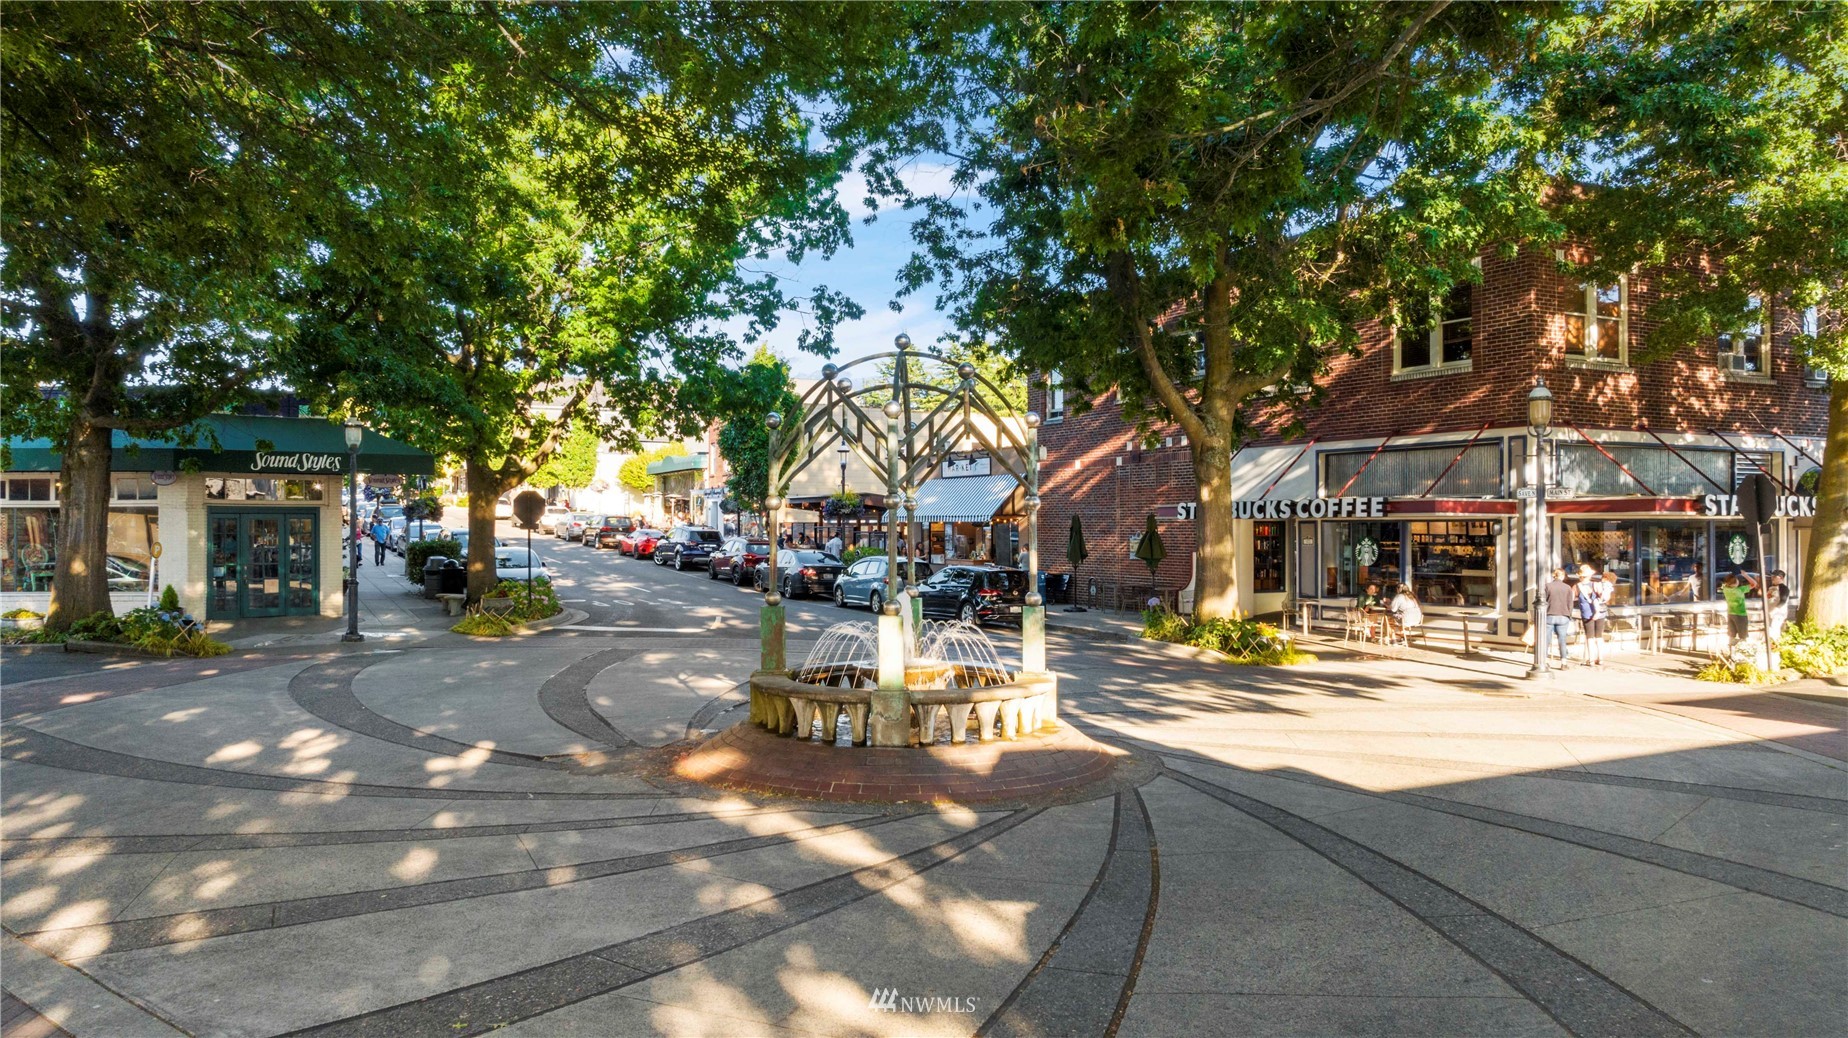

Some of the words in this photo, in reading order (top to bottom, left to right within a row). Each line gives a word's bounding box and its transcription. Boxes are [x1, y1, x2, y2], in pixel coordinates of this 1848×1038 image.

[250, 451, 299, 471] Sound
[297, 452, 342, 472] Styles
[1296, 497, 1384, 519] COFFEE
